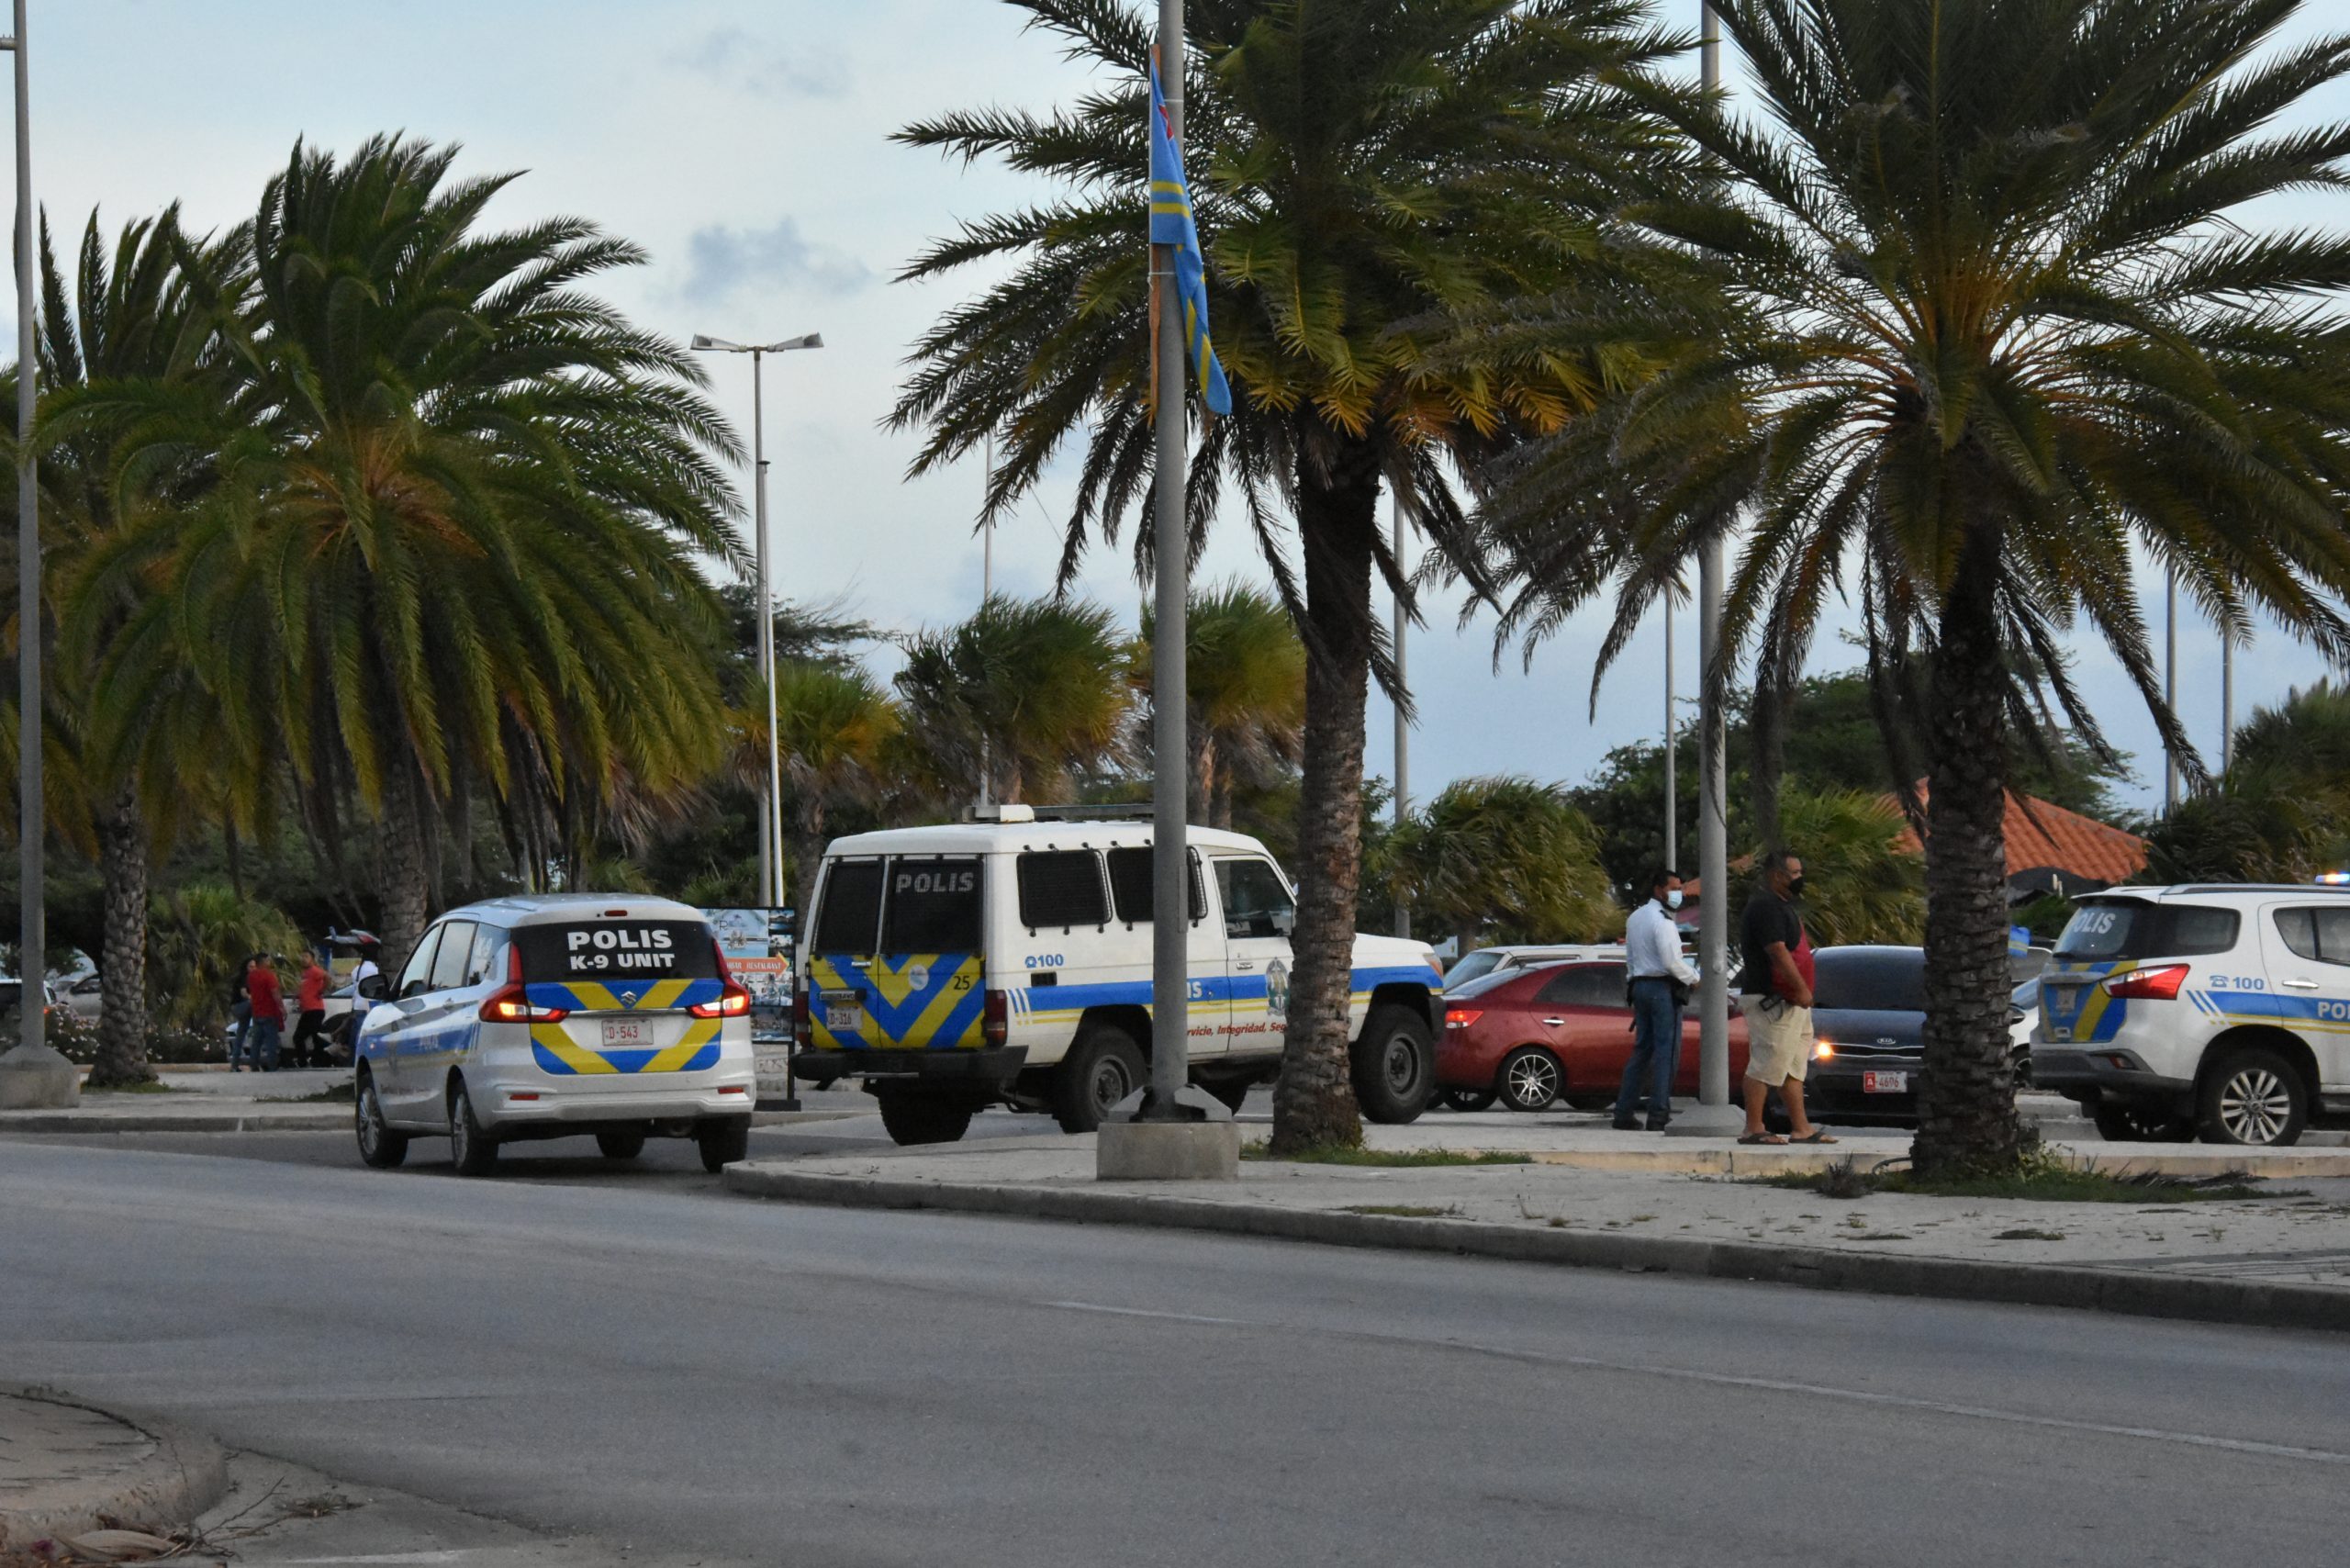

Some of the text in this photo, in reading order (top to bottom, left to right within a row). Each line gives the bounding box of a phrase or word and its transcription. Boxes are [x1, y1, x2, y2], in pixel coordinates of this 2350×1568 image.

[896, 872, 974, 893] POLIS
[2073, 913, 2116, 935] OLIS
[567, 929, 672, 951] POLIS
[570, 953, 675, 969] K-9 UNIT
[746, 961, 782, 970] RESTAURANT
[1036, 954, 1065, 968] 100
[954, 975, 971, 991] 25
[2232, 977, 2265, 991] 100
[1187, 1025, 1214, 1037] rvicio,
[1217, 1022, 1267, 1036] Integridad,
